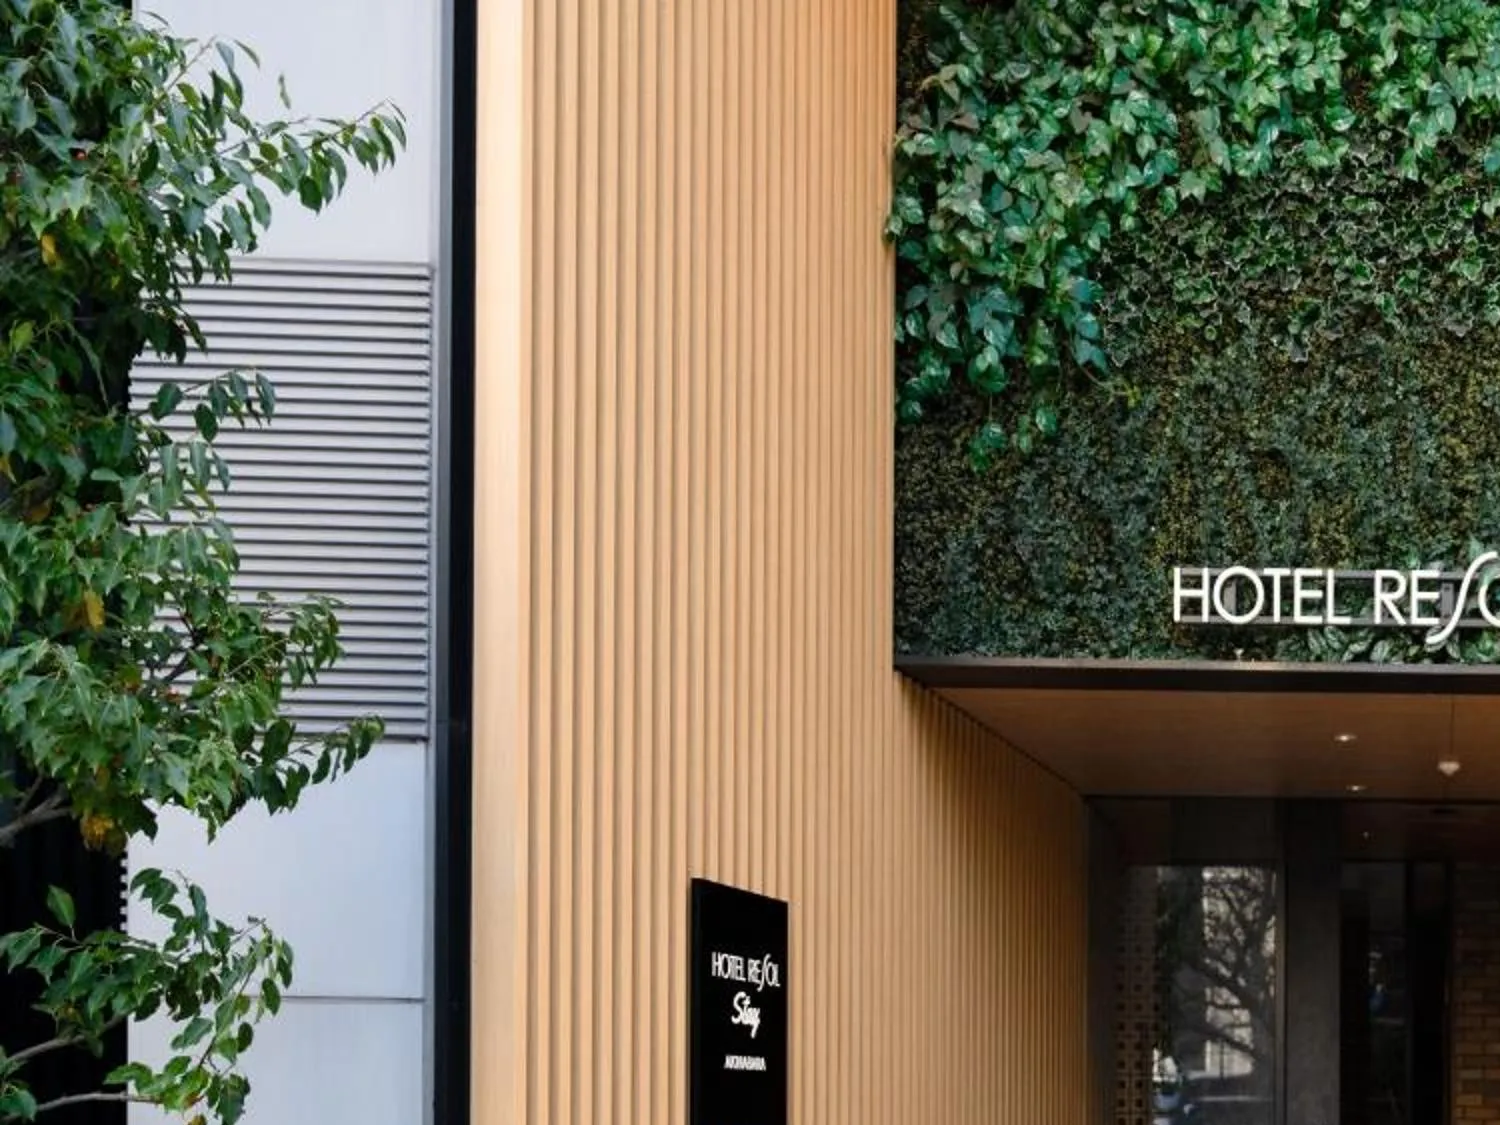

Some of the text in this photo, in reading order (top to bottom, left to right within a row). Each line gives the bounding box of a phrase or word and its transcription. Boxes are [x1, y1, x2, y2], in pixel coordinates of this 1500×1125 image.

[1174, 566, 1353, 625] HOTEL
[711, 951, 746, 982] HOTEL
[731, 991, 761, 1039] Stay
